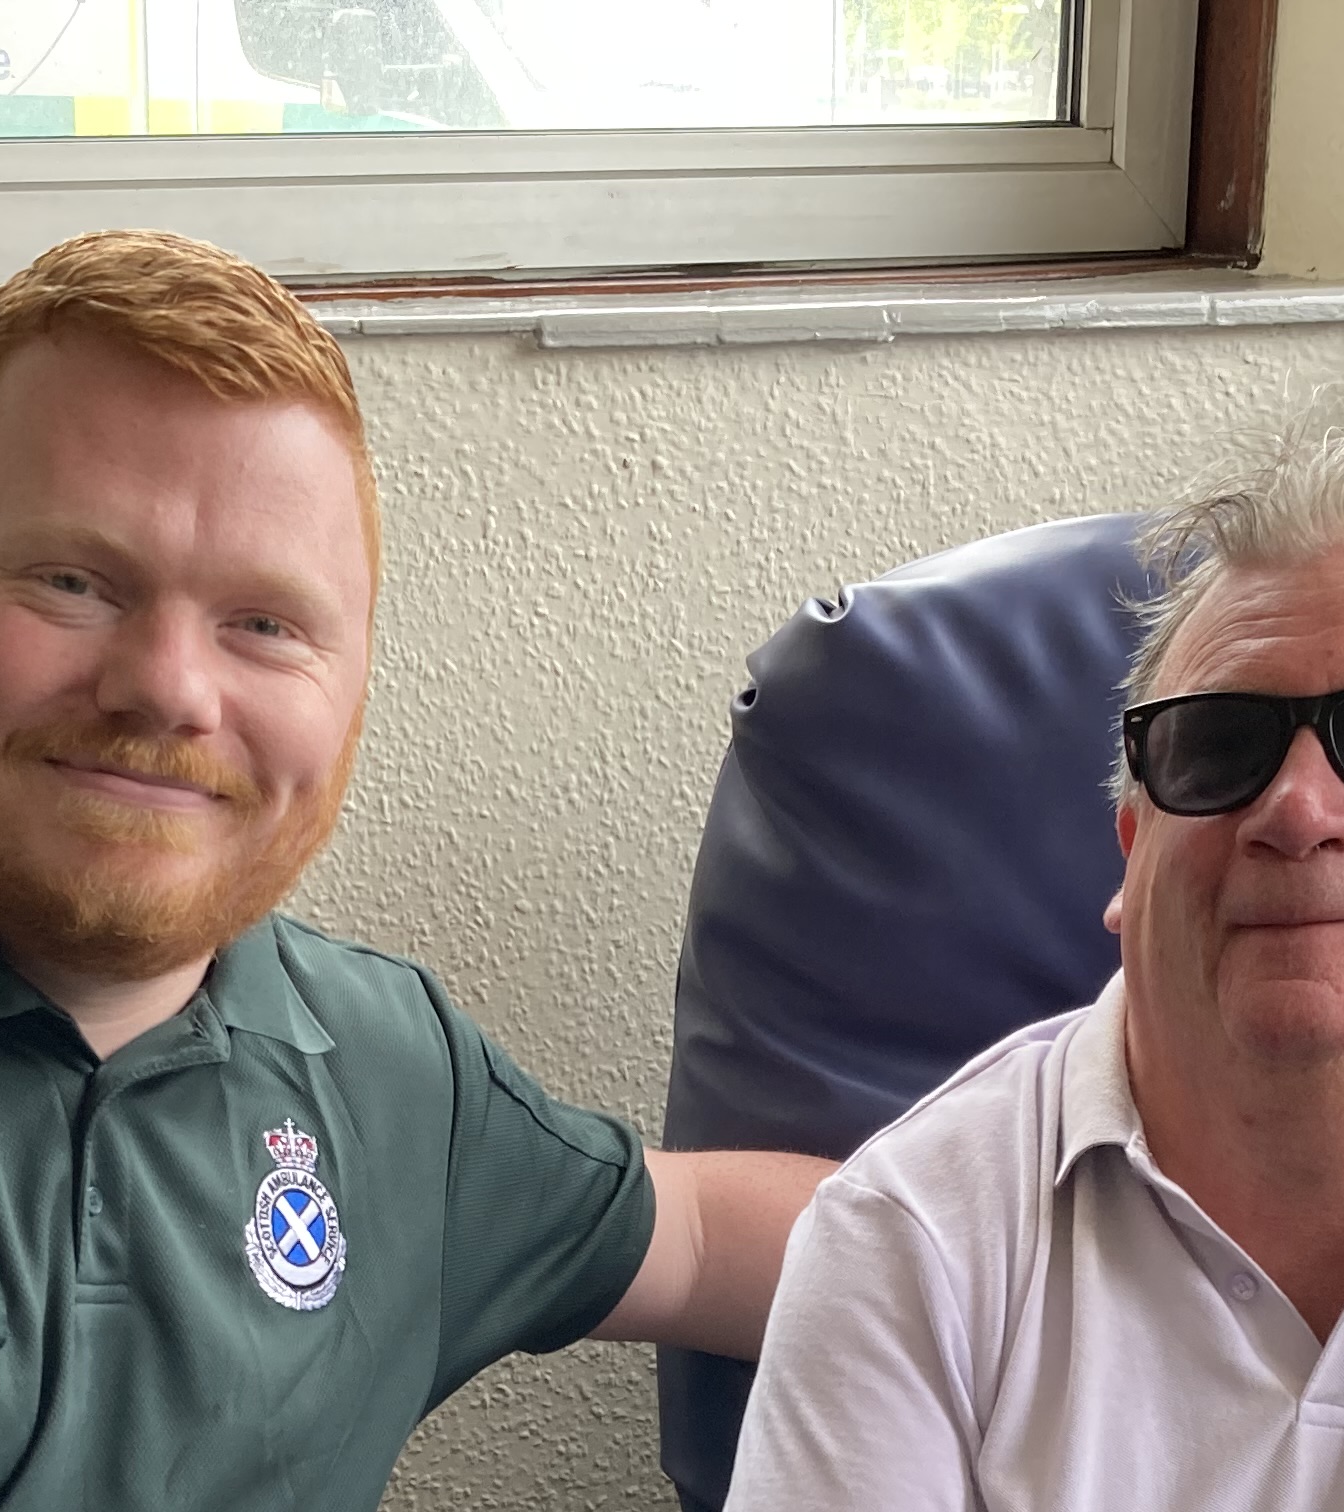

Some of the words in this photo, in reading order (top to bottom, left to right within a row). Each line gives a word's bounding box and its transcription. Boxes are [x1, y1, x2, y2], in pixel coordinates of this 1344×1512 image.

[267, 1171, 330, 1205] AMBULANCE
[257, 1191, 278, 1261] SCOTTISH
[320, 1205, 336, 1266] SERVICE
